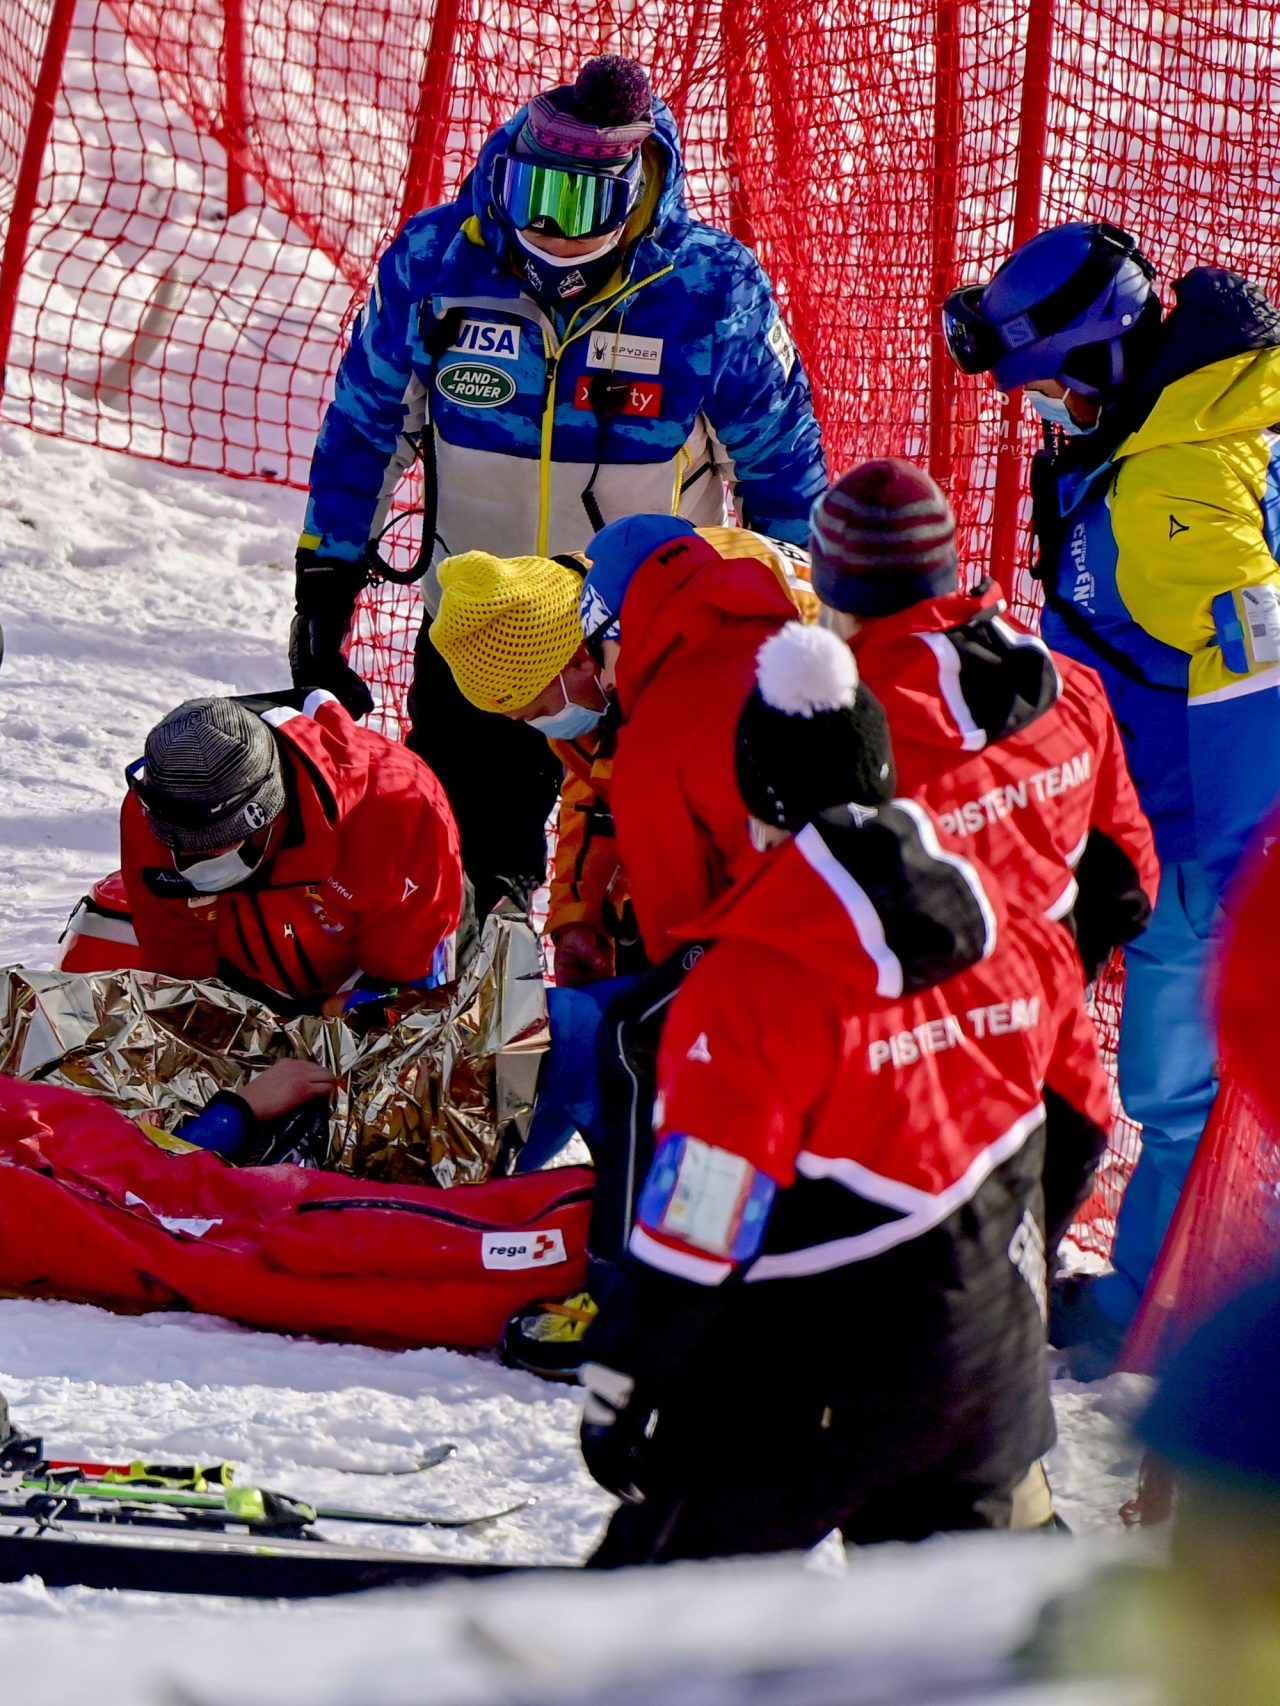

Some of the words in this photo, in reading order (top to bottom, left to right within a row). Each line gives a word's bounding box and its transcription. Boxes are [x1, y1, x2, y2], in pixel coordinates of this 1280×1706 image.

[455, 323, 516, 355] VISA
[452, 369, 490, 385] LAND
[455, 383, 502, 400] ROVER
[938, 780, 1029, 838] PISTEN
[1029, 751, 1092, 803] TEAM
[868, 1014, 968, 1076] PISTEN
[966, 995, 1041, 1040] TEAM
[489, 1244, 527, 1257] rega
